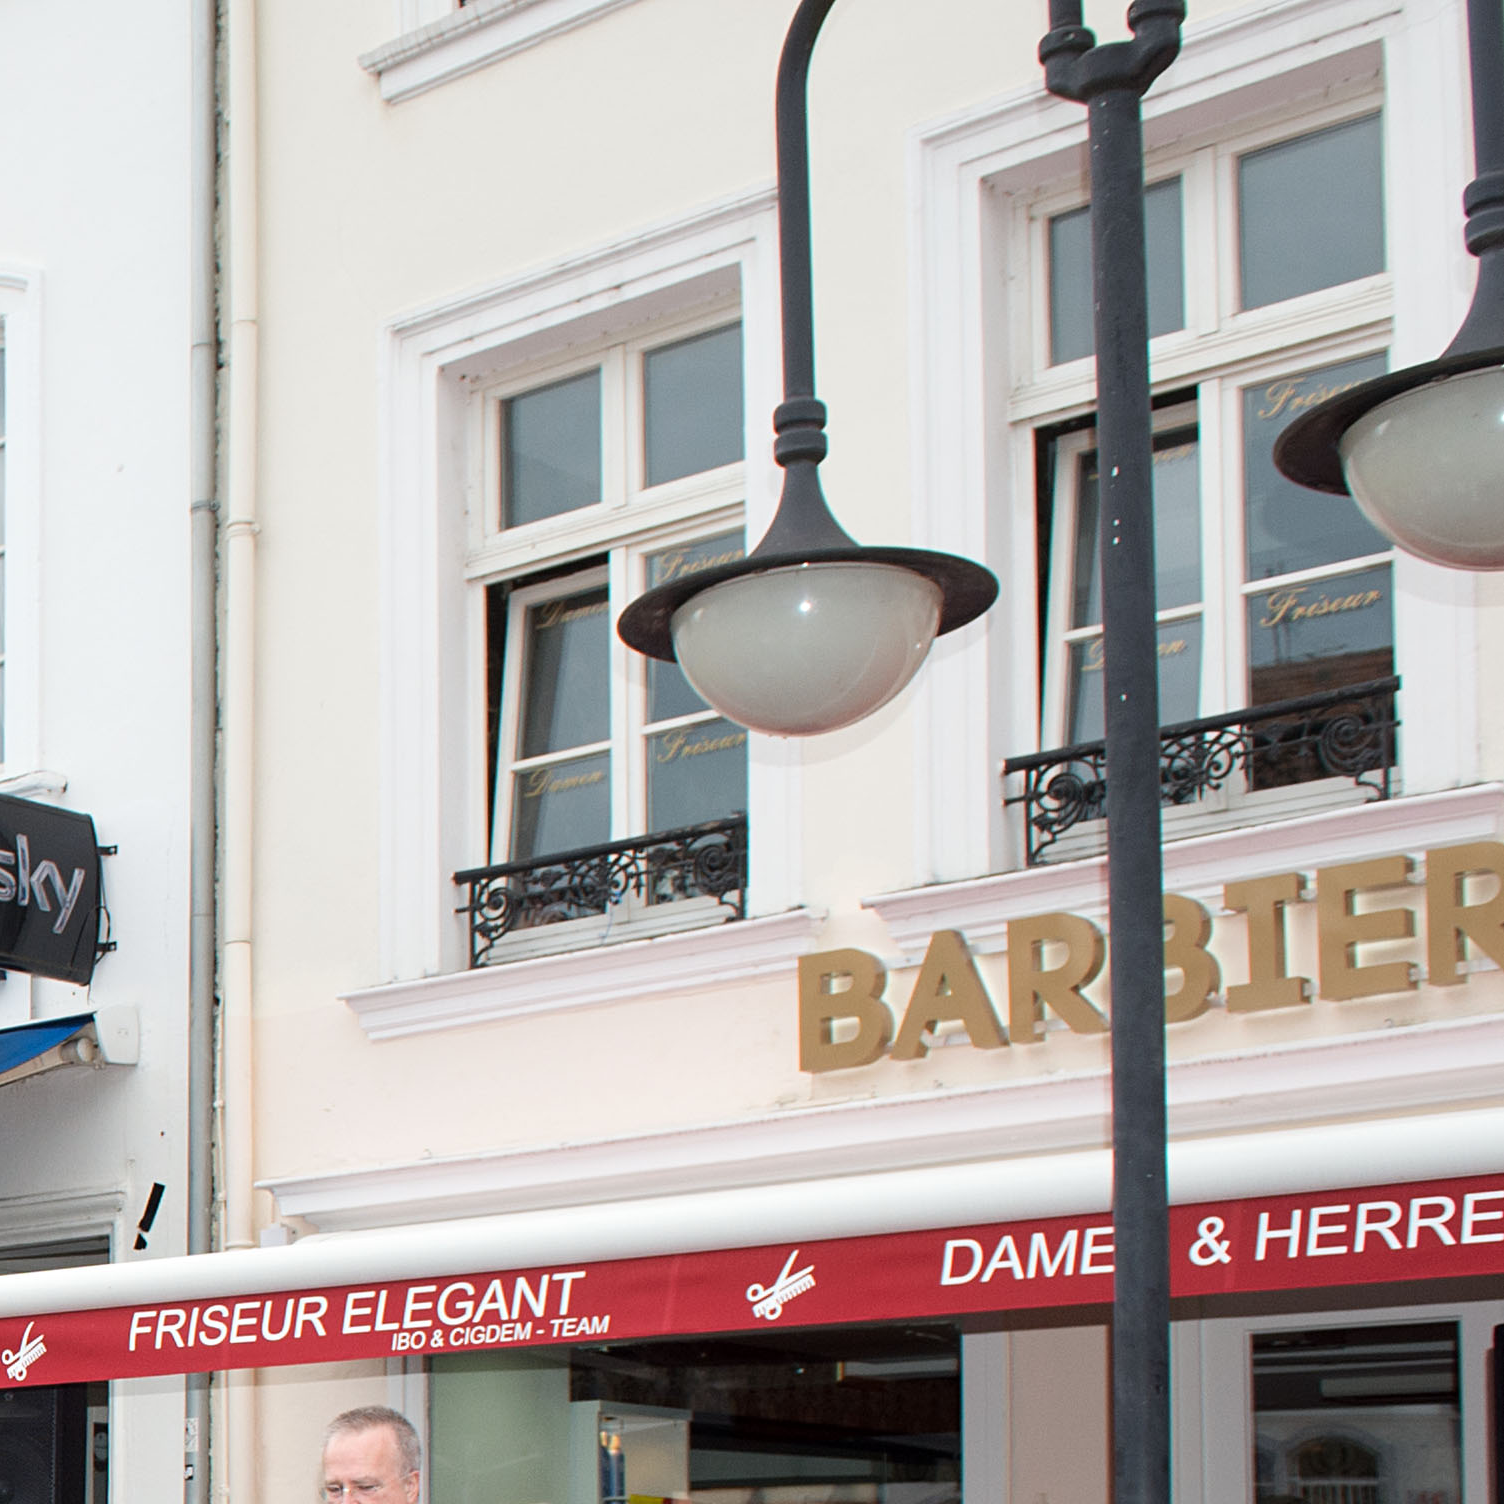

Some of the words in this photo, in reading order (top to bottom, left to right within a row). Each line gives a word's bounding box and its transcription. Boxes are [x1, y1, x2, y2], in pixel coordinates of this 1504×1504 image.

[1258, 377, 1373, 419] Frise
[1260, 587, 1381, 628] Friseur
[658, 730, 746, 763] Friseur
[525, 768, 604, 798] Damen
[940, 1226, 1115, 1287] DAME
[1188, 1215, 1233, 1267] &
[127, 1294, 329, 1353] FRISEUR
[341, 1269, 587, 1336] ELEGANT
[390, 1331, 427, 1353] IBO
[430, 1328, 445, 1349] &
[448, 1320, 534, 1347] CIGDEM
[548, 1313, 611, 1340] TEAM
